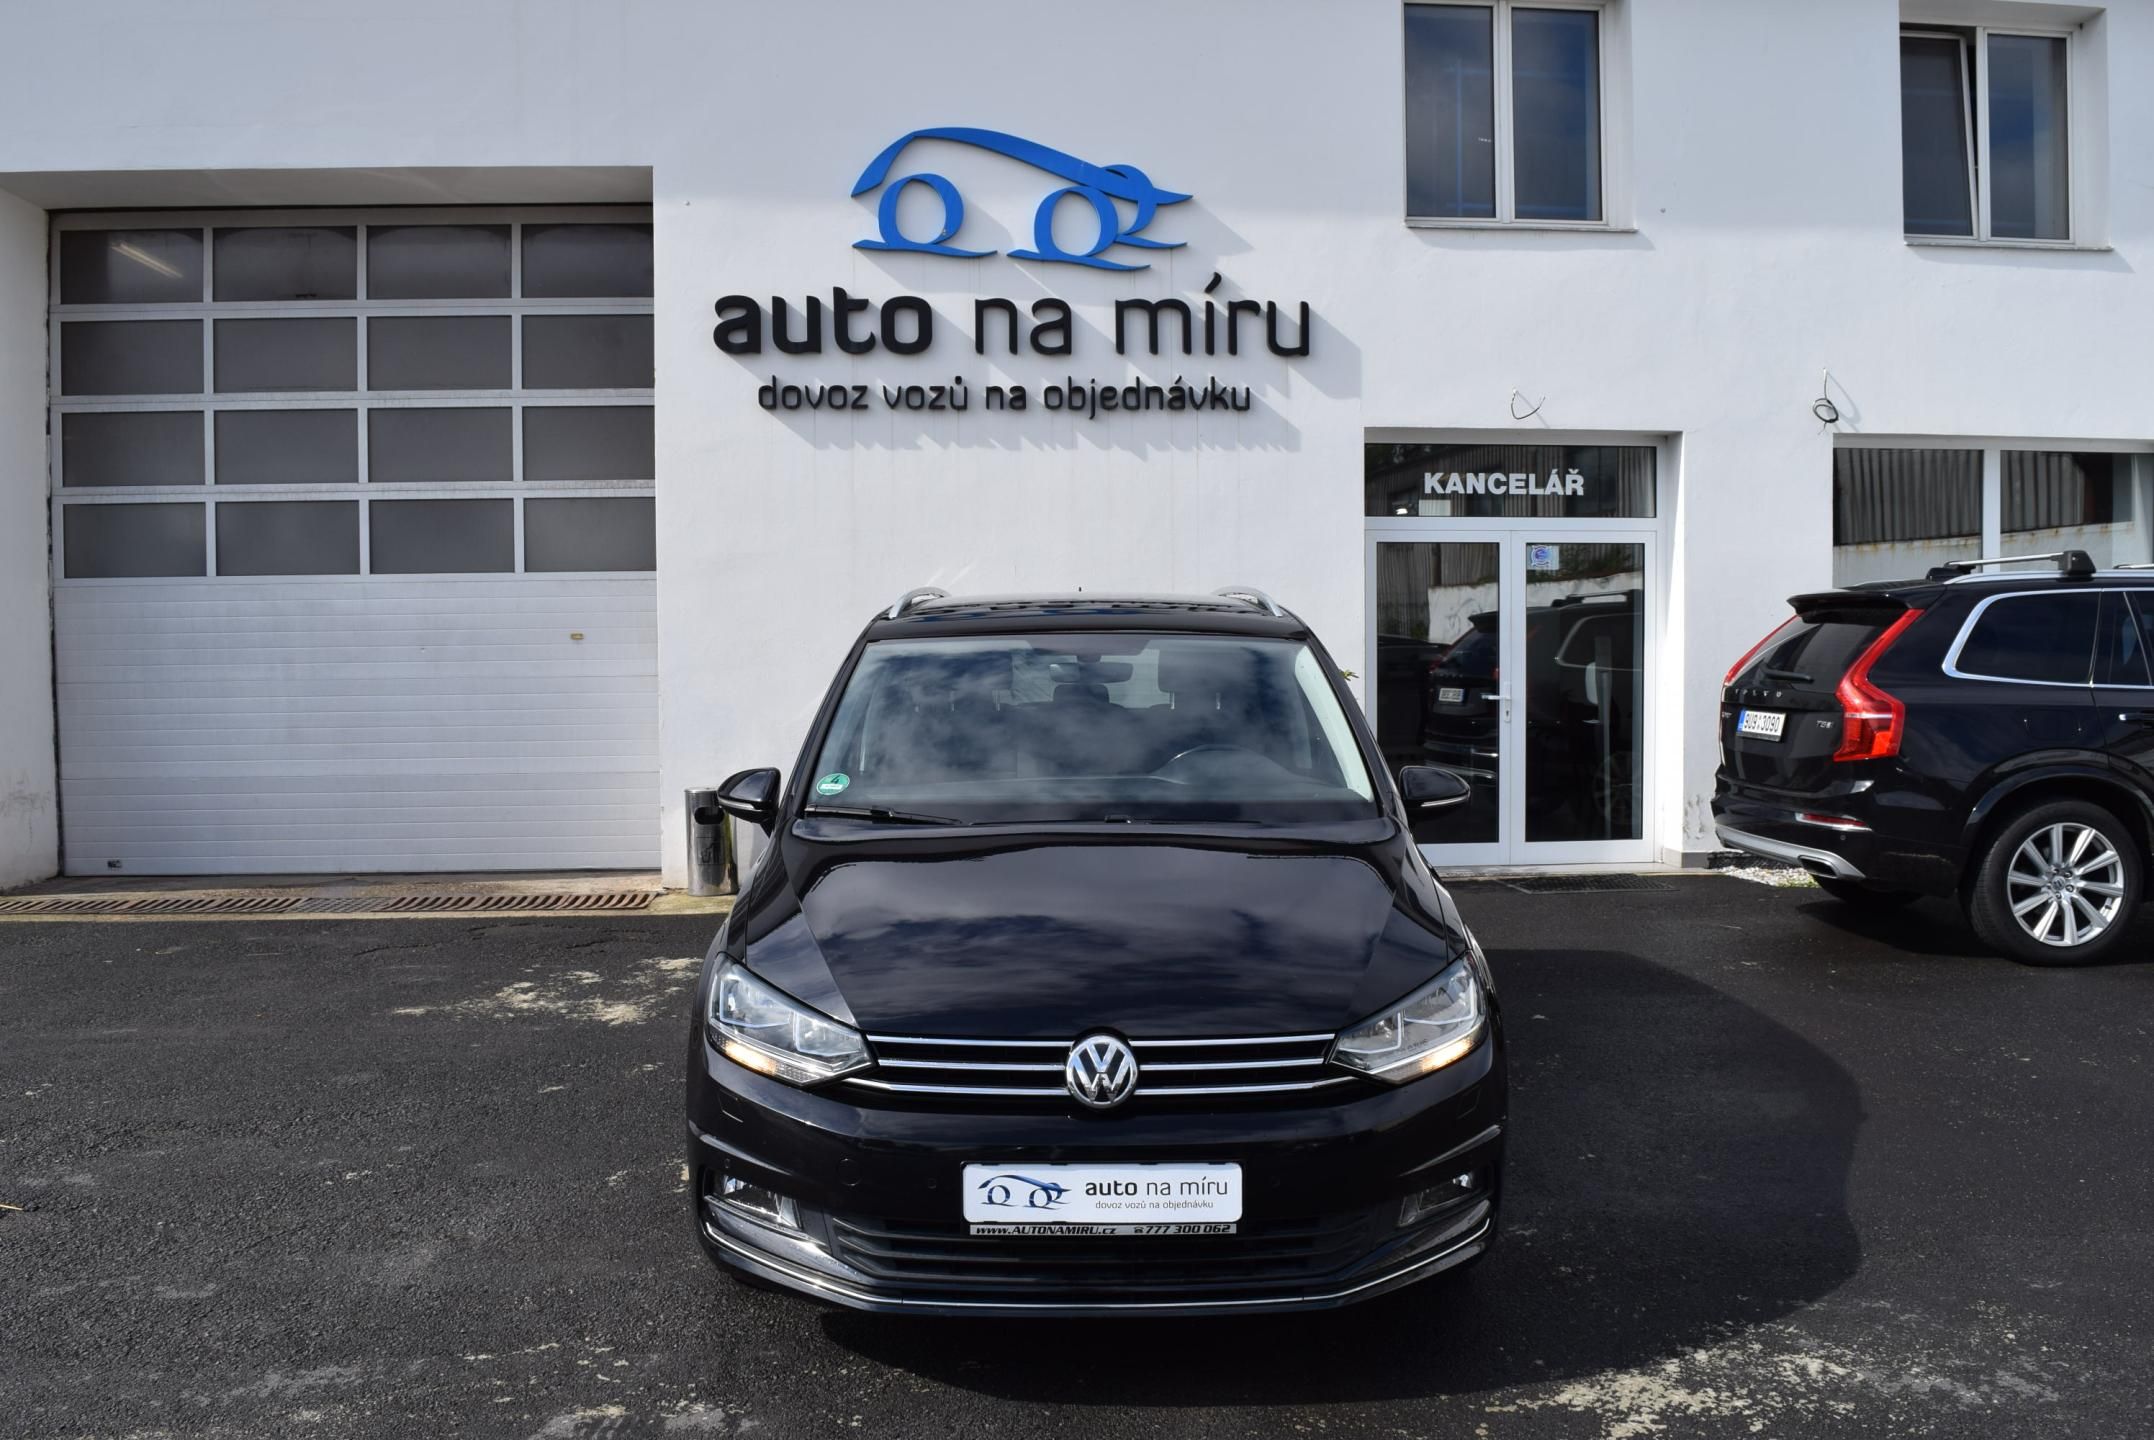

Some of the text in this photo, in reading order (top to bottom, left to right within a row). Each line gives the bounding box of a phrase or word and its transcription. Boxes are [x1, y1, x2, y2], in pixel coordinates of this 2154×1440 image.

[713, 272, 1310, 358] auto na míru
[757, 375, 1252, 420] dovoz vozů na objednávku
[1424, 468, 1584, 496] KANCELÁŘ
[1085, 1175, 1228, 1196] auto na míru
[1095, 1200, 1122, 1209] dovoz
[1125, 1200, 1146, 1209] vozů
[1162, 1199, 1214, 1211] objednávku
[1145, 1225, 1172, 1234] 777
